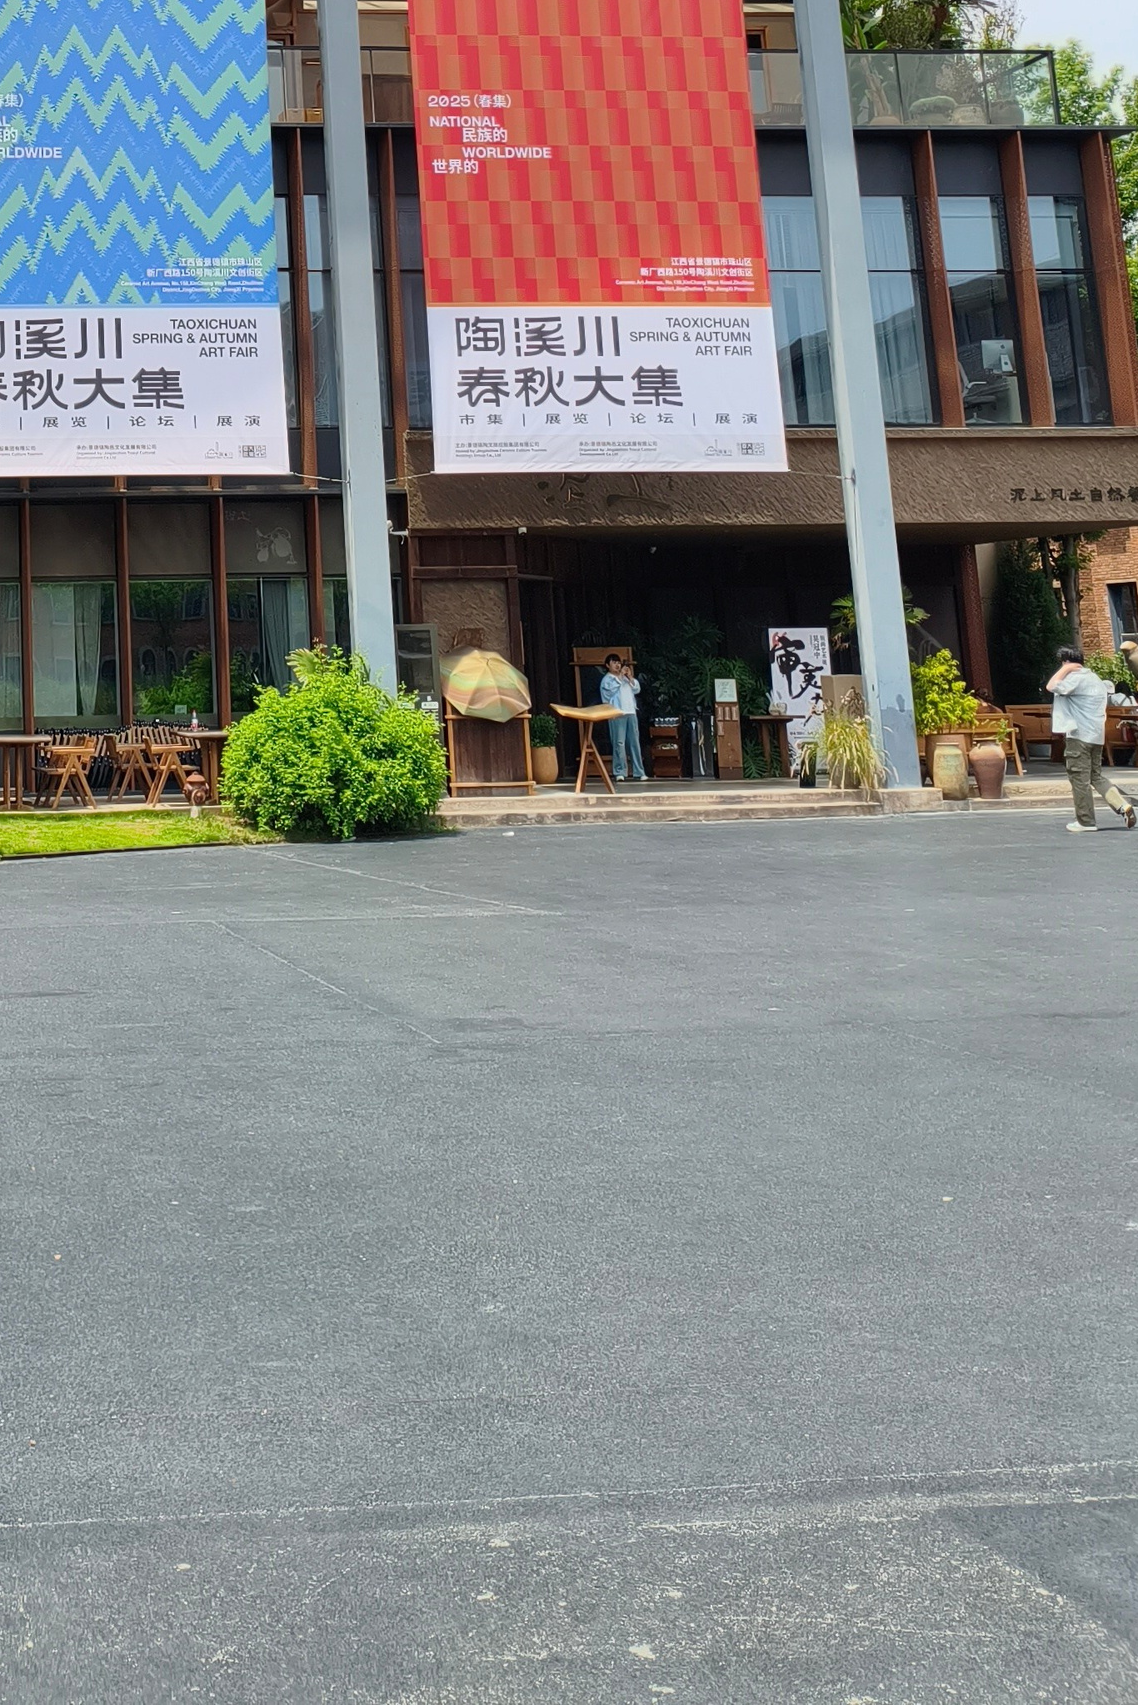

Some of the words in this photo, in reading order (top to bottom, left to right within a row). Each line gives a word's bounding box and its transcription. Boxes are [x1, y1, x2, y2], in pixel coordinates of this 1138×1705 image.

[429, 116, 499, 128] NATIONAL
[462, 127, 508, 143] 民族的
[462, 147, 552, 159] WORLDWIDE
[432, 159, 478, 174] 世界的
[170, 319, 257, 330] TAOXICHUAN
[666, 317, 750, 328] TAOXICHUAN
[132, 333, 183, 344] SPRING
[187, 333, 195, 344] &
[199, 332, 258, 344] AUTUMN
[455, 316, 621, 357] 陶溪川
[630, 331, 679, 342] SPRING
[683, 331, 691, 342] &
[695, 331, 751, 342] AUTUMN
[199, 347, 224, 358] ART
[229, 347, 258, 358] FAIR
[695, 345, 720, 356] ART
[725, 345, 752, 356] FAIR
[457, 364, 683, 407] 春秋大集
